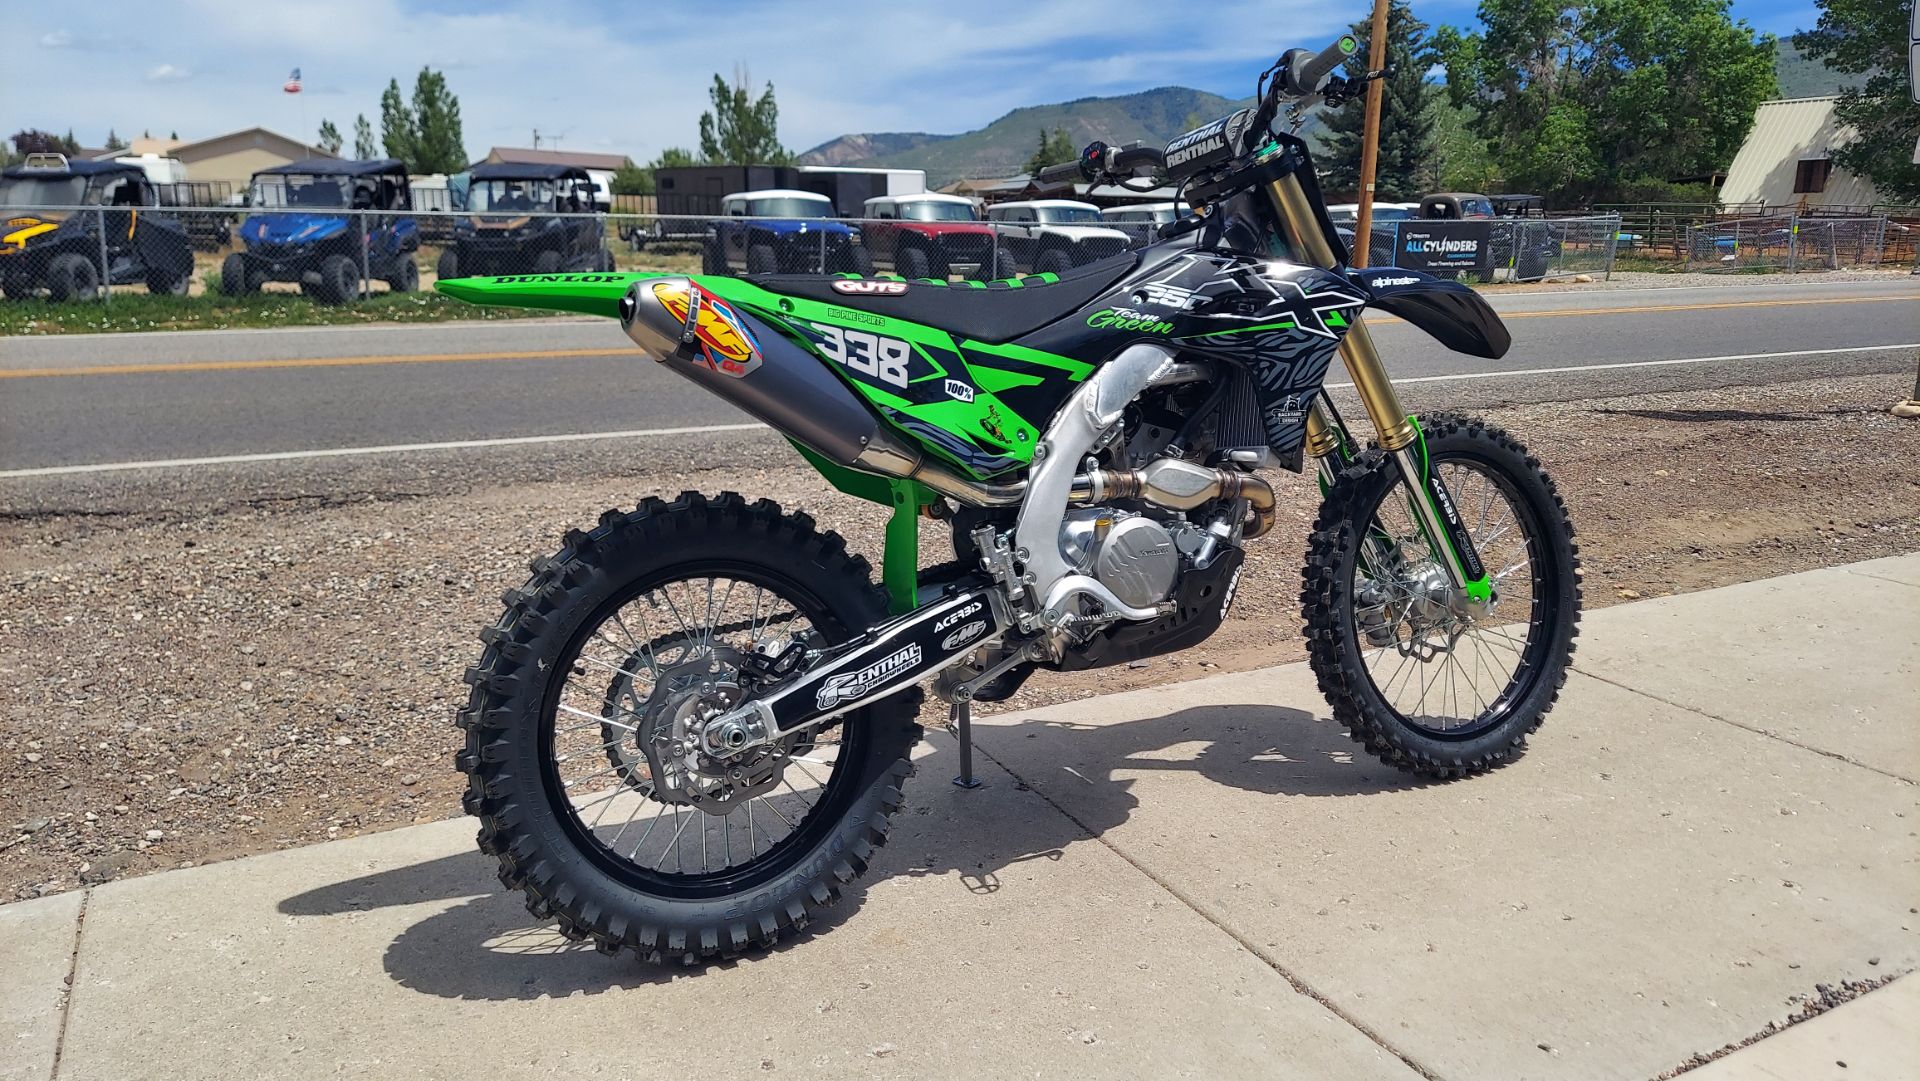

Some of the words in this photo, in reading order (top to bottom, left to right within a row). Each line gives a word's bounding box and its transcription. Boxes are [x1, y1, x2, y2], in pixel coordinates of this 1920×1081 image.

[1167, 122, 1225, 152] RENTHAL
[1166, 137, 1225, 169] RENTHAL
[491, 273, 625, 285] DUNLOP
[833, 280, 908, 293] GUTS
[828, 307, 841, 319] BIG
[841, 310, 858, 322] PINE
[858, 312, 886, 327] SPORTS
[1086, 309, 1176, 336] Green
[1111, 307, 1160, 323] Team
[810, 322, 911, 390] 338
[946, 381, 973, 400] 100%
[1431, 477, 1458, 526] ACERBIS
[933, 601, 983, 634] ACERBIS
[943, 619, 986, 651] FMF
[817, 645, 921, 708] RENTHAL
[867, 656, 921, 689] CHAINWHEELS
